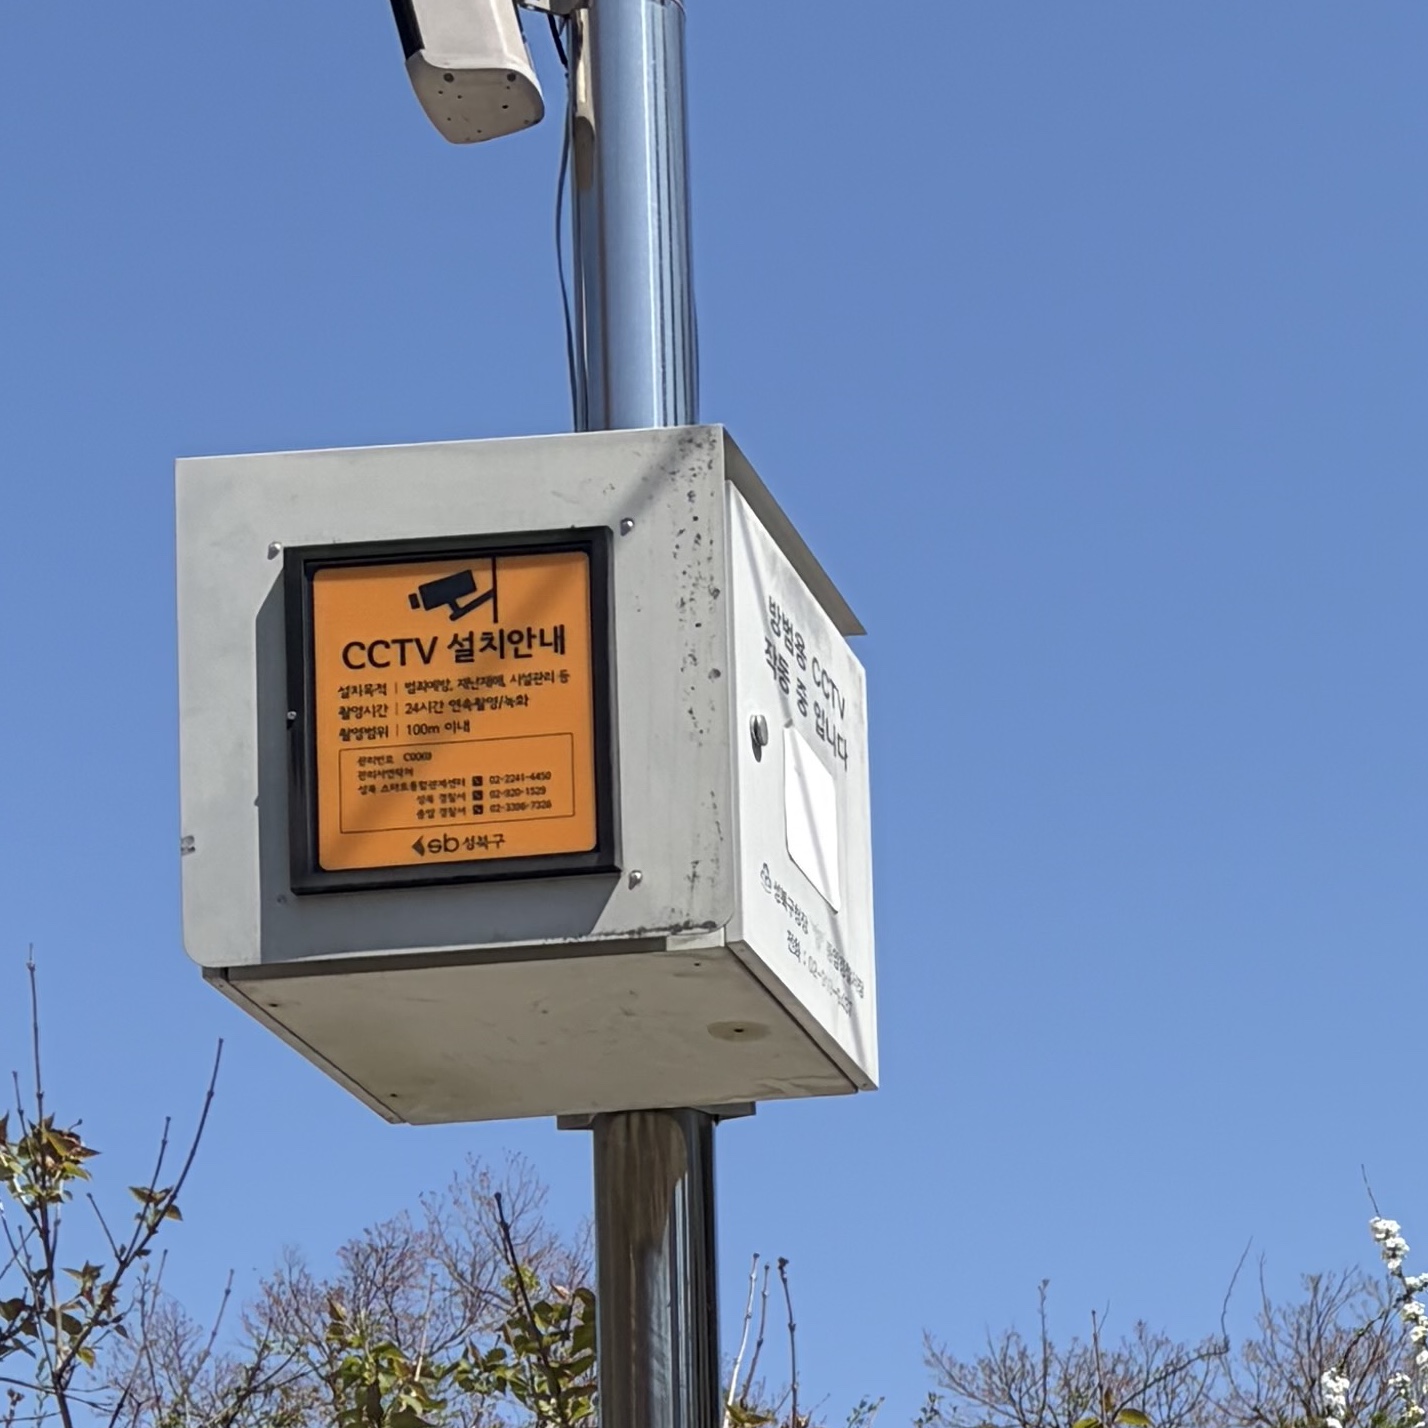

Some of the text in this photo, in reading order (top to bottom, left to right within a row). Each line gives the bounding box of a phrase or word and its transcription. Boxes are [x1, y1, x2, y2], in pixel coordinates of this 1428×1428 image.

[341, 624, 566, 670] CCTV 설치안내
[768, 594, 846, 720] 방범용 CCTV
[404, 699, 445, 716] 24시간
[764, 636, 849, 773] 작동 중 입니다
[406, 722, 441, 736] 100m
[444, 718, 472, 735] 이내
[427, 833, 506, 854] sb 성북구
